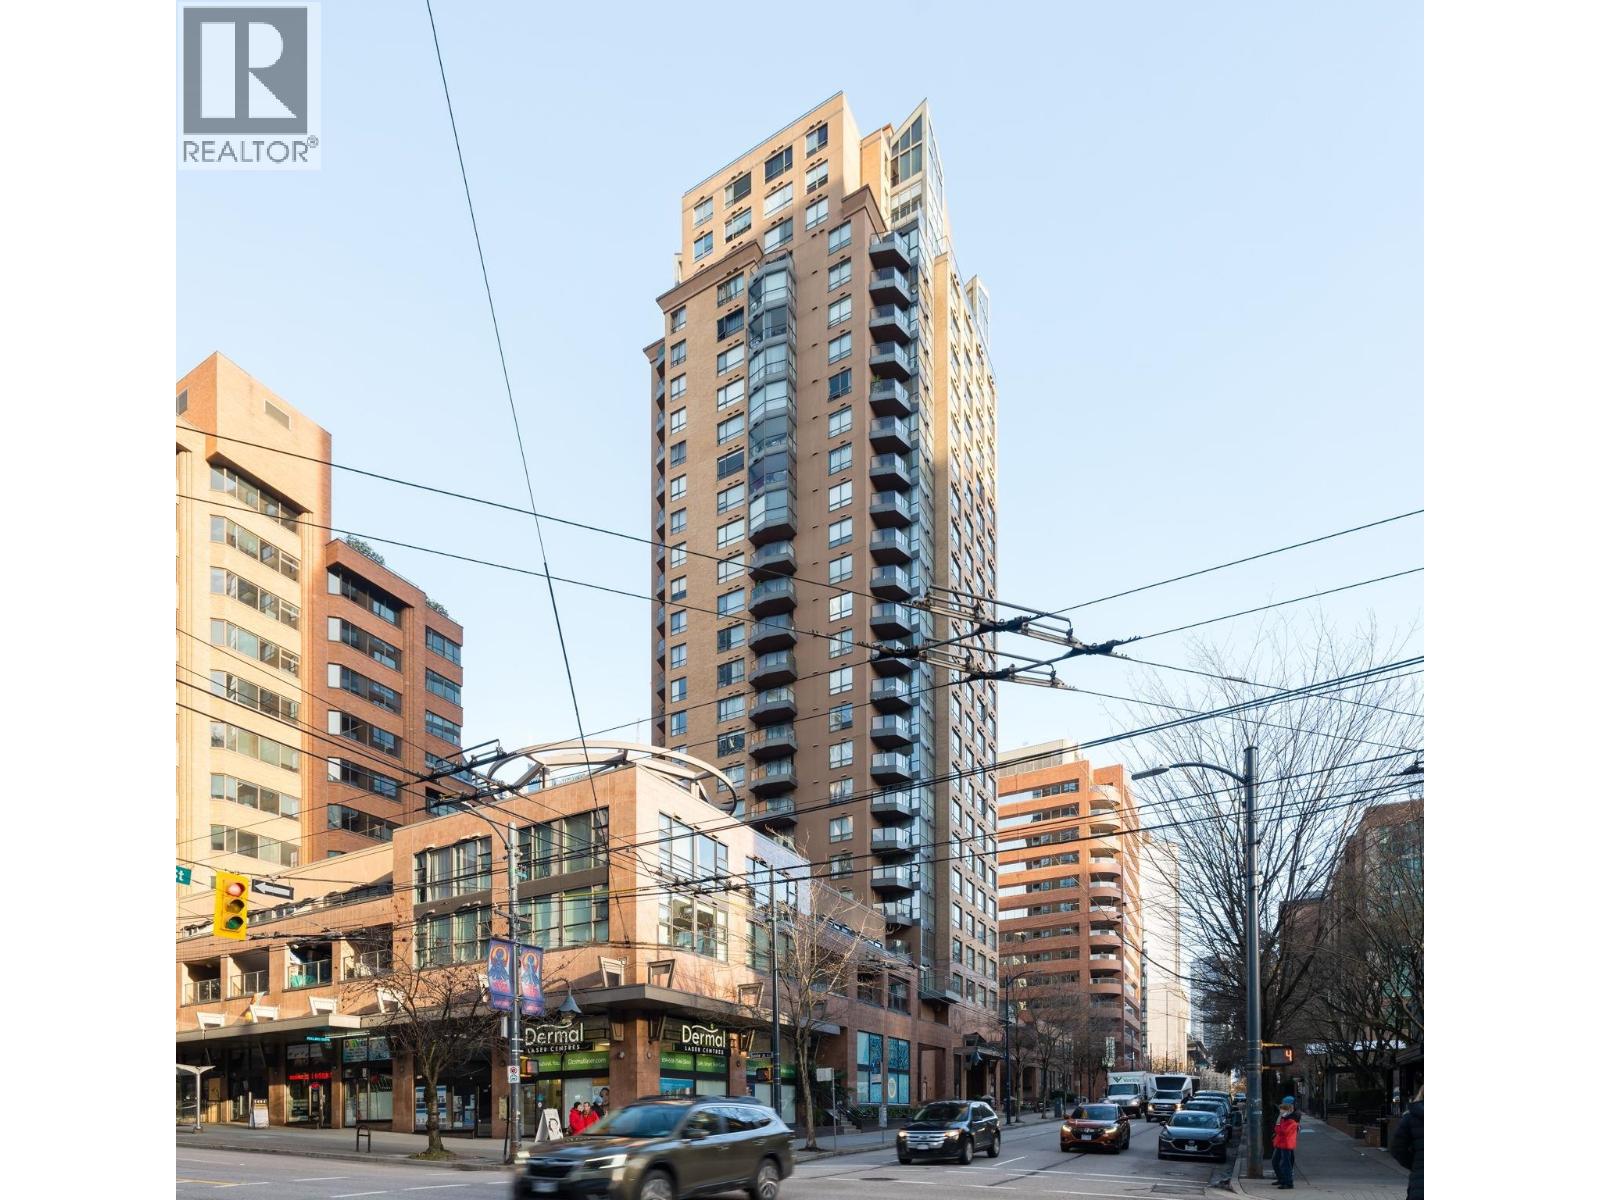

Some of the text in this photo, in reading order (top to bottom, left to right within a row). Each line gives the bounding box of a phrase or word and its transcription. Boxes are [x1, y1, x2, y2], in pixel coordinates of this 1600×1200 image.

[525, 1022, 584, 1046] Dermal
[682, 1024, 726, 1048] Dermal
[550, 1044, 581, 1052] CENTRES
[684, 1045, 701, 1053] LASER
[1285, 1049, 1293, 1062] 4
